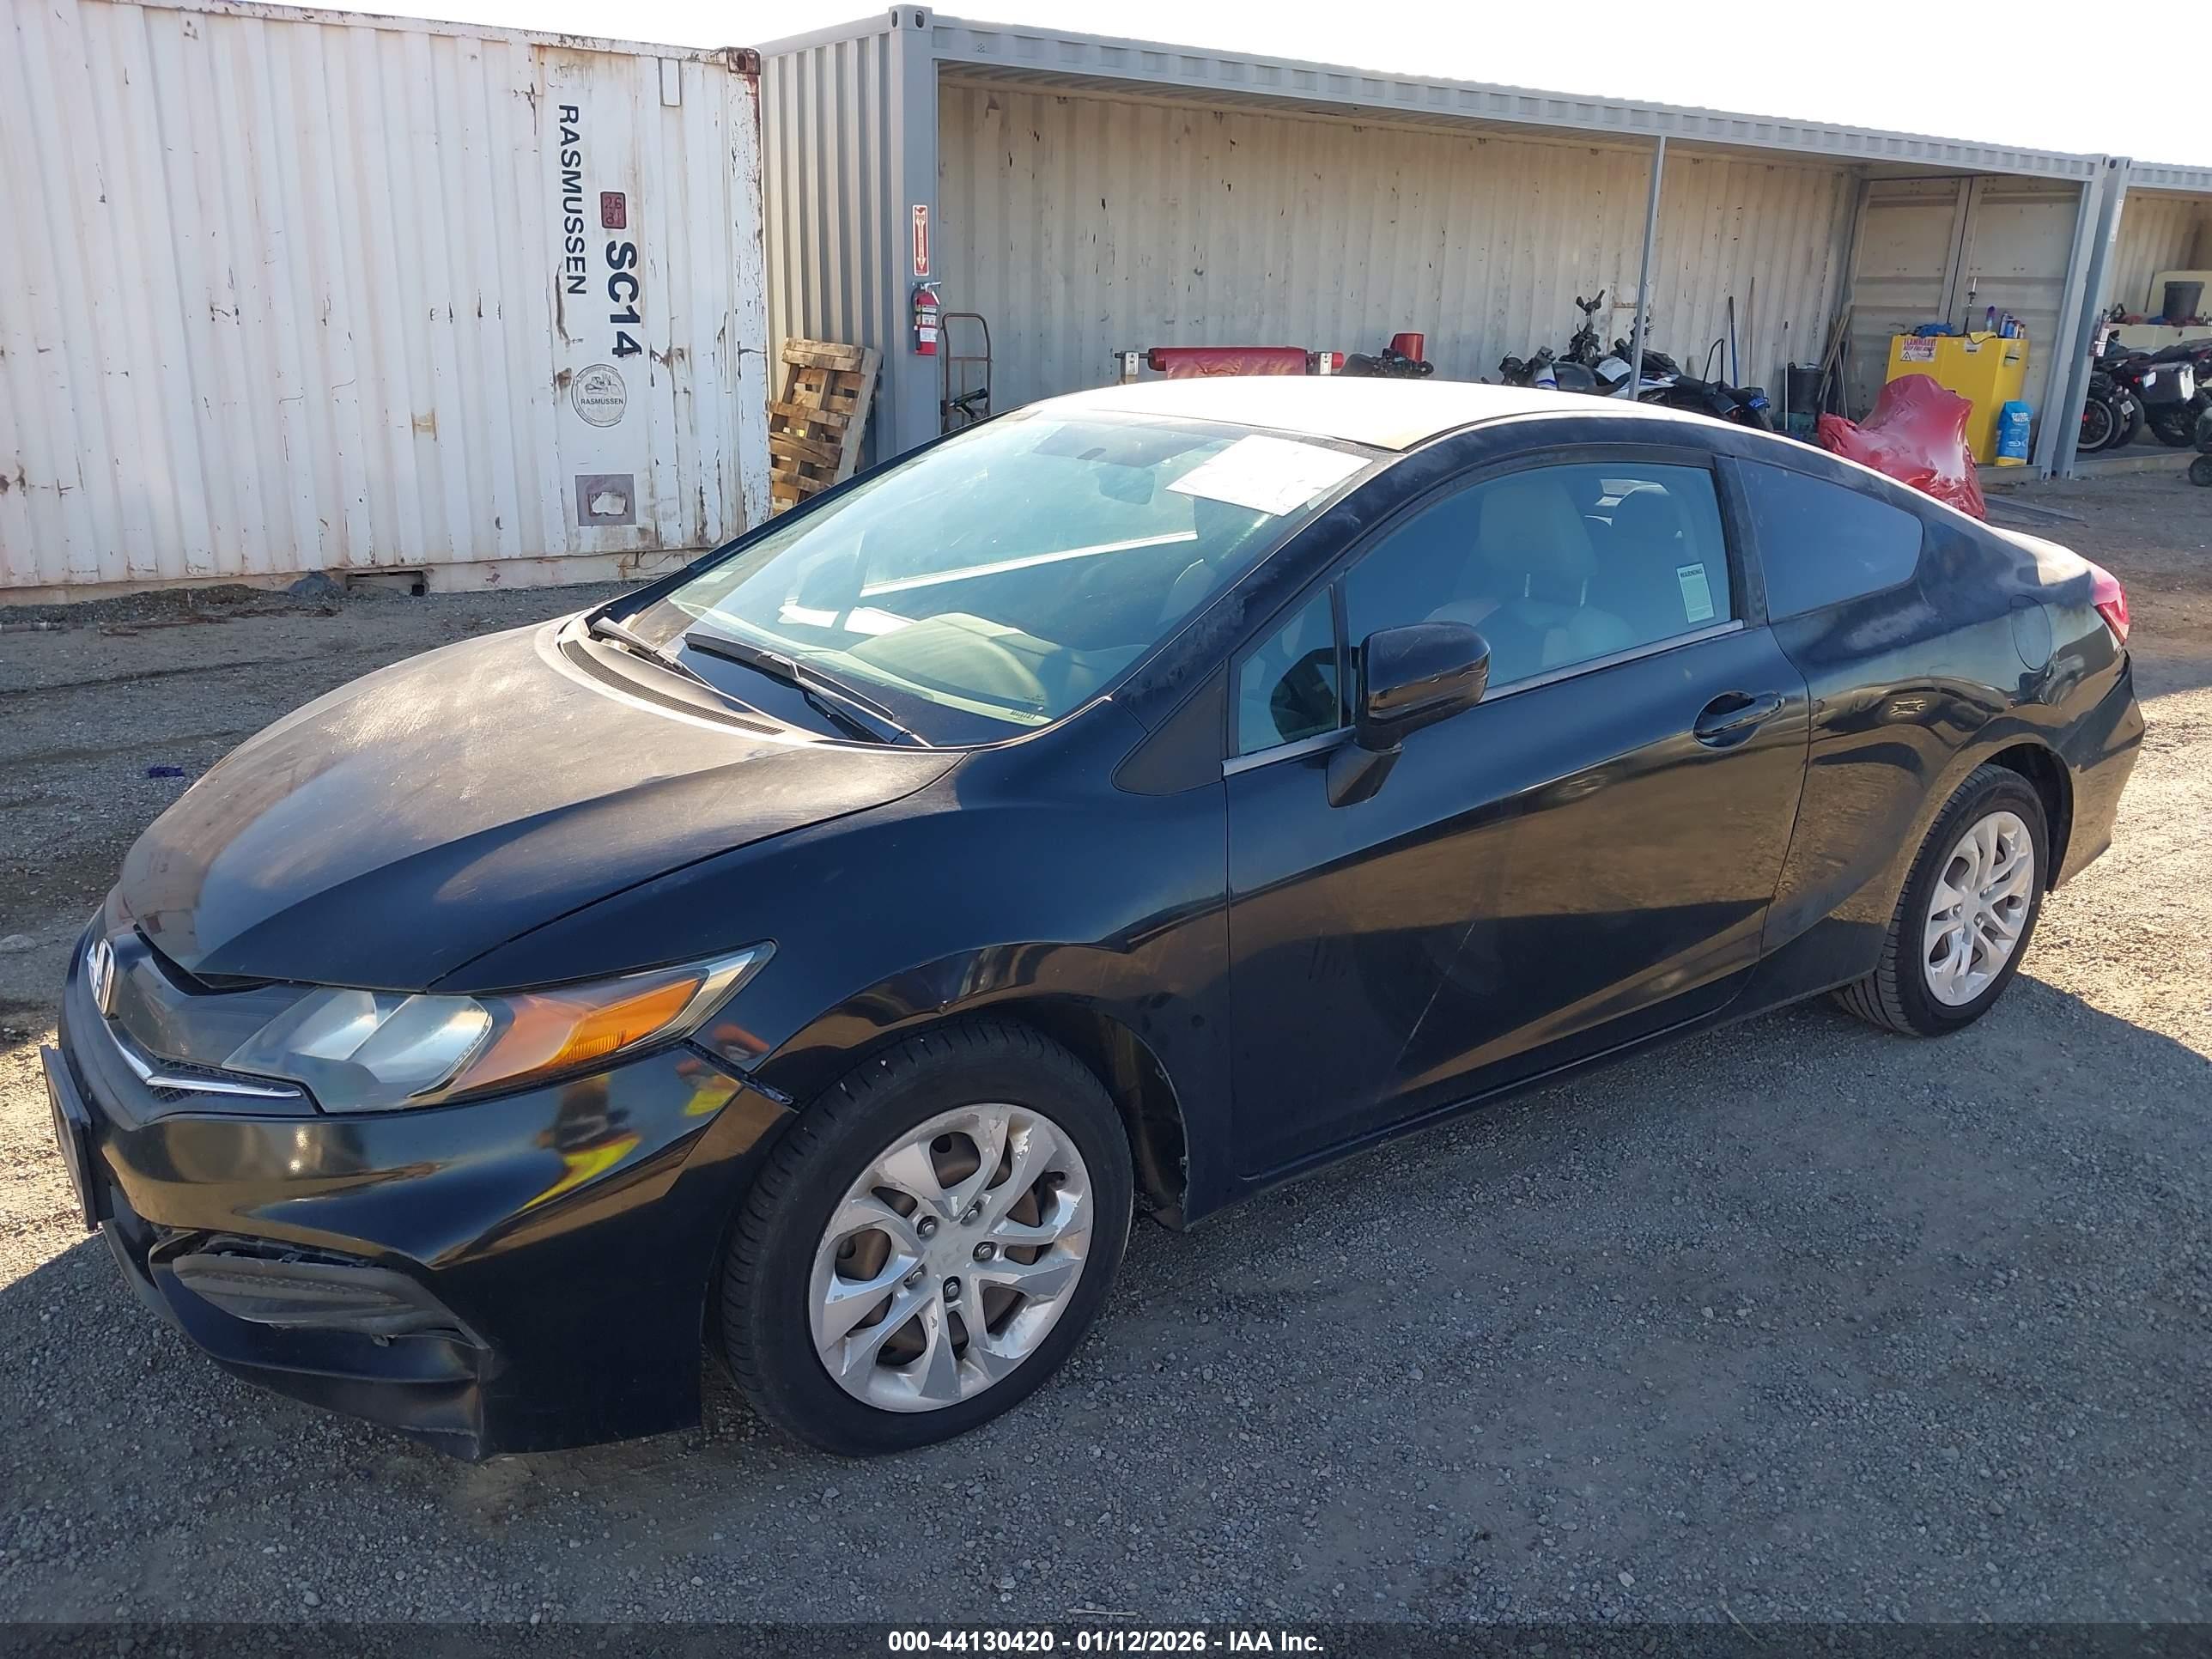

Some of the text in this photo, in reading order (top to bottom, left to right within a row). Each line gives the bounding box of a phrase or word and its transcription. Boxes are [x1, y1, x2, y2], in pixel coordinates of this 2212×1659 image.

[558, 104, 586, 295] RASMUSSEN
[605, 240, 642, 358] SC14
[1680, 568, 1704, 578] WARNING
